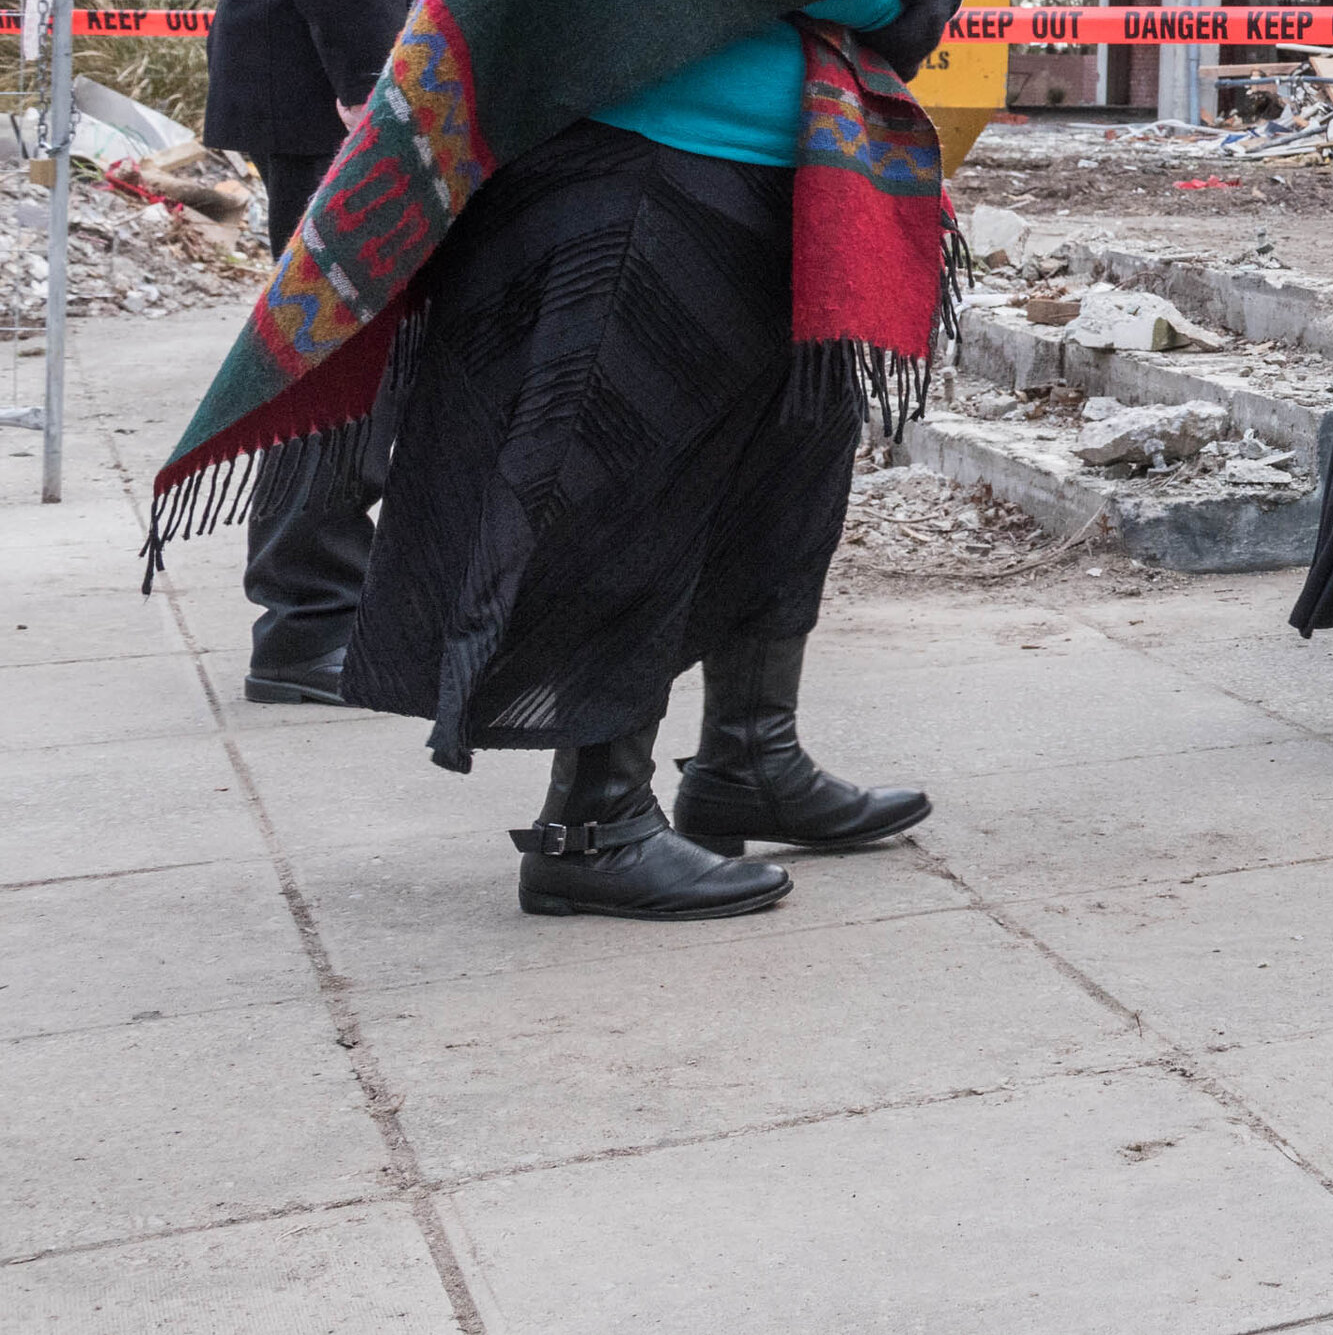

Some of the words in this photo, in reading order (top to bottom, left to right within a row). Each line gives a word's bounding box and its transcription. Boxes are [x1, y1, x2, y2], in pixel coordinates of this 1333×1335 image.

[87, 10, 147, 31] KEEP
[950, 10, 1013, 39] KEEP
[1031, 10, 1083, 39] OUT
[1124, 10, 1229, 40] DANGER
[1246, 10, 1314, 40] KEEP
